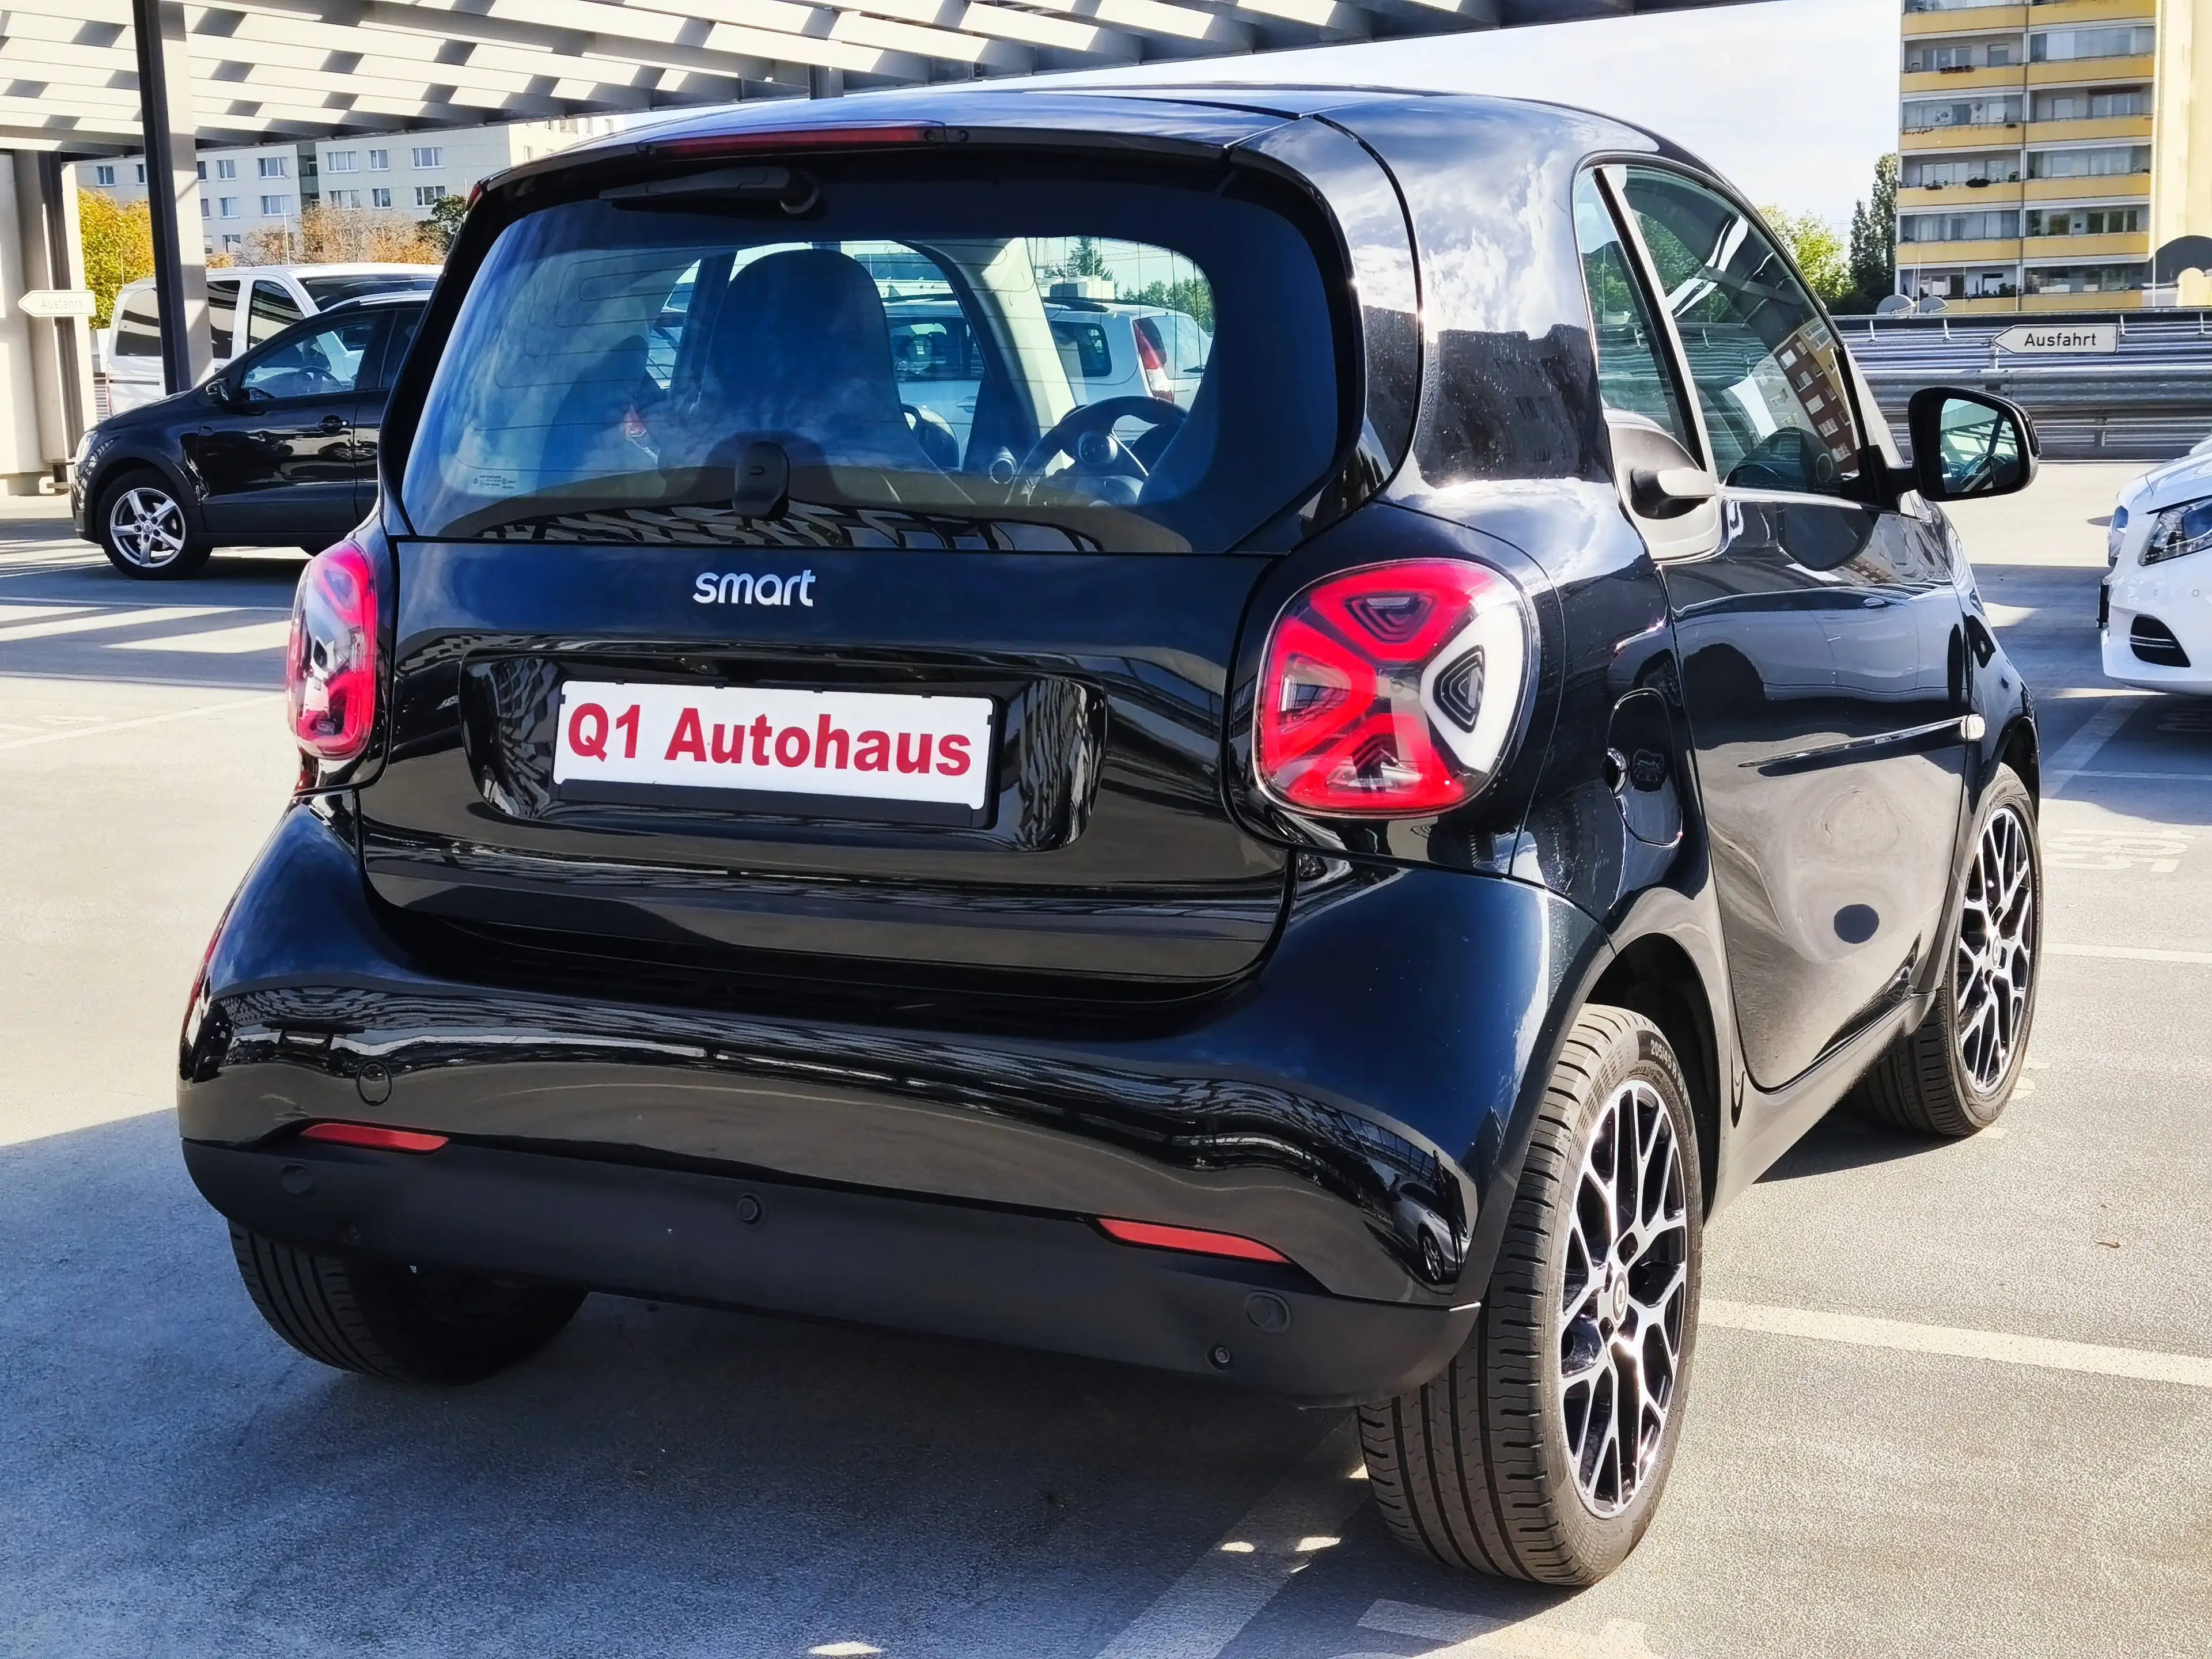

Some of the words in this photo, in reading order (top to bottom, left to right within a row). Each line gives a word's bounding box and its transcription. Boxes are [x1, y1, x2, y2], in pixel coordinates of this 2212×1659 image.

[2024, 332, 2096, 347] Ausfahrt
[692, 569, 816, 607] smart
[568, 703, 641, 762] Q1
[664, 707, 971, 777] Autohaus
[1650, 1039, 1672, 1070] 205/45
[1672, 1062, 1677, 1079] R
